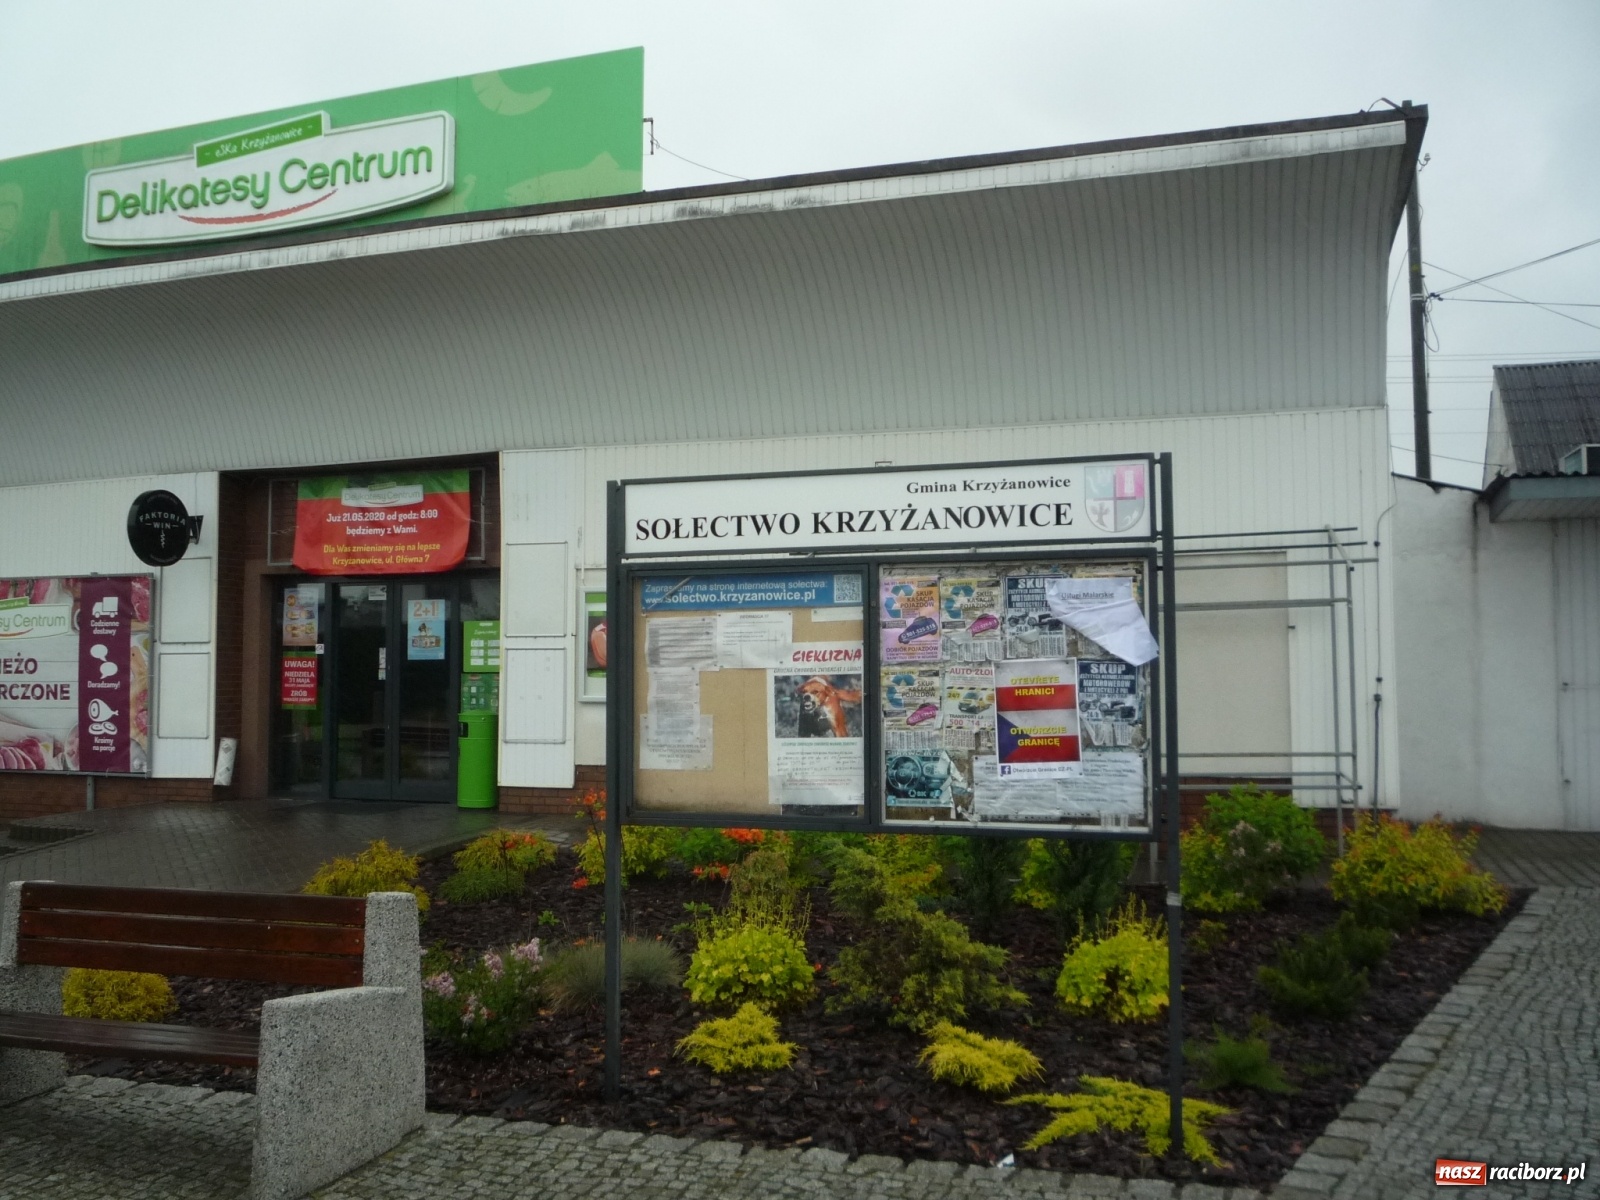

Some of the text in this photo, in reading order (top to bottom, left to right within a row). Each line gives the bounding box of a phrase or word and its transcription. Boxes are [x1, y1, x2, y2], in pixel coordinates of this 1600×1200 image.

[97, 145, 433, 223] Delikatesy Centrum
[906, 475, 1071, 494] Gmina Krzyżanowice
[139, 511, 186, 526] FAKTORIA
[342, 511, 386, 522] 21.05.2020
[386, 512, 397, 521] od
[397, 511, 419, 523] godz:
[420, 509, 438, 519] 8:00
[635, 502, 1074, 541] SOŁECTWO KRZYŻANOWICE
[152, 521, 171, 529] WIN
[346, 525, 418, 537] będziemy z Wami.
[323, 545, 335, 553] Dla
[336, 544, 352, 553] Was
[352, 544, 394, 555] zmieniamy
[394, 543, 406, 554] się
[417, 543, 441, 553] lepsze
[385, 556, 395, 564] ul.
[395, 555, 424, 565] Główna
[424, 554, 430, 563] 7
[645, 581, 695, 595] Zaprasmy
[696, 582, 707, 591] na
[709, 581, 736, 593] stronę
[737, 578, 786, 591] internetową
[1017, 578, 1045, 589] SKU
[13, 613, 66, 628] Centrum
[90, 619, 119, 628] Codzienne
[93, 627, 117, 635] dostawy
[284, 660, 315, 668] UWAGA!
[1090, 663, 1126, 674] SKUP
[284, 670, 315, 678] NIEDZIELA
[949, 668, 972, 676] AUTO
[88, 680, 121, 690] Doradzamy!
[1010, 675, 1060, 686] OTEVŘETE
[1014, 686, 1055, 697] HRANICI
[1010, 725, 1067, 736] OTWÓRZCIE
[94, 736, 114, 746] Kroimy
[1017, 737, 1061, 748] GRANICĘ
[92, 744, 101, 752] na
